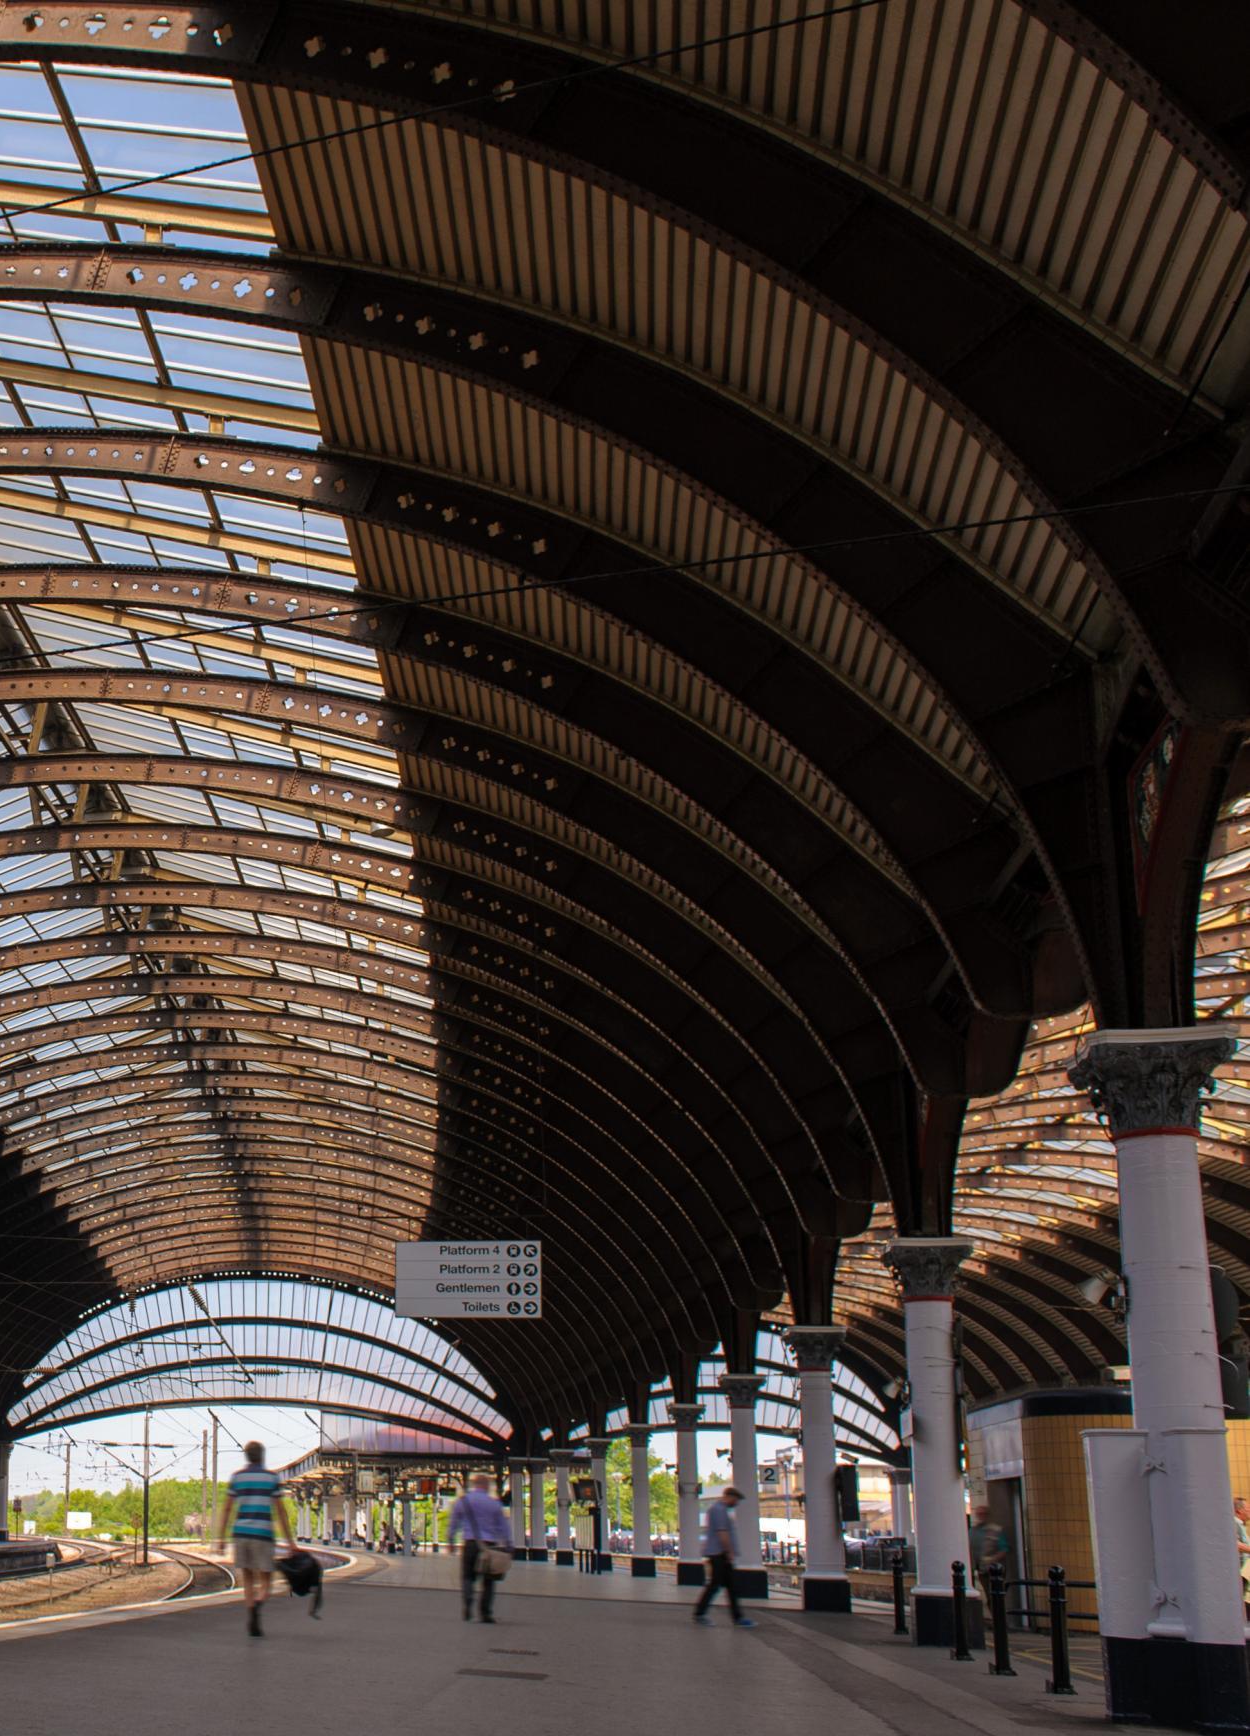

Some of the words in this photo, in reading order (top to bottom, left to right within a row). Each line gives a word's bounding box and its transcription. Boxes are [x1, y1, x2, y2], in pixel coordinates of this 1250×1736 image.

[439, 1245, 490, 1255] Platform
[492, 1245, 500, 1255] 4
[439, 1264, 490, 1274] Platform
[493, 1264, 500, 1274] 2
[436, 1283, 500, 1293] Gentlemen
[462, 1302, 500, 1312] Toilets
[764, 1467, 775, 1481] 2
